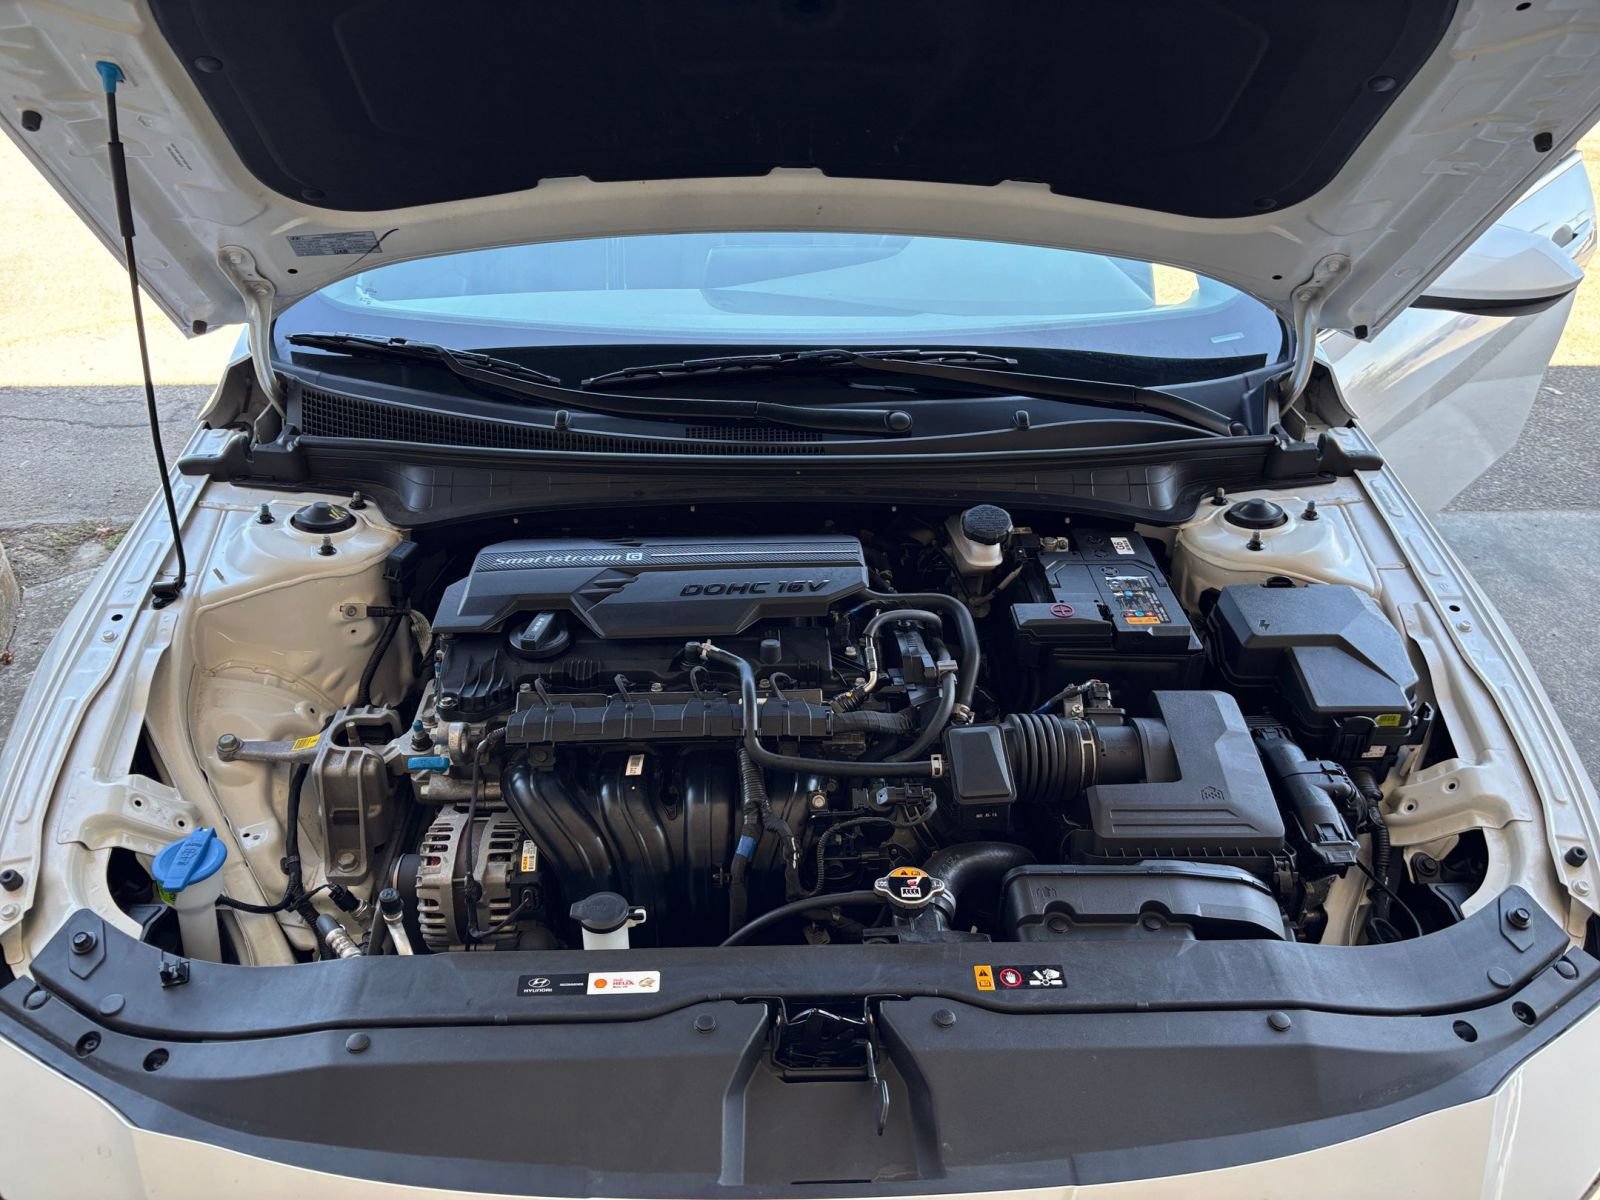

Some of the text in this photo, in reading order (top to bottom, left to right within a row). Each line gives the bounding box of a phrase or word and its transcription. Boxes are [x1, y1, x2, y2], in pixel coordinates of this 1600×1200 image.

[495, 554, 622, 565] Smartstream
[680, 579, 831, 597] DOHC 16V
